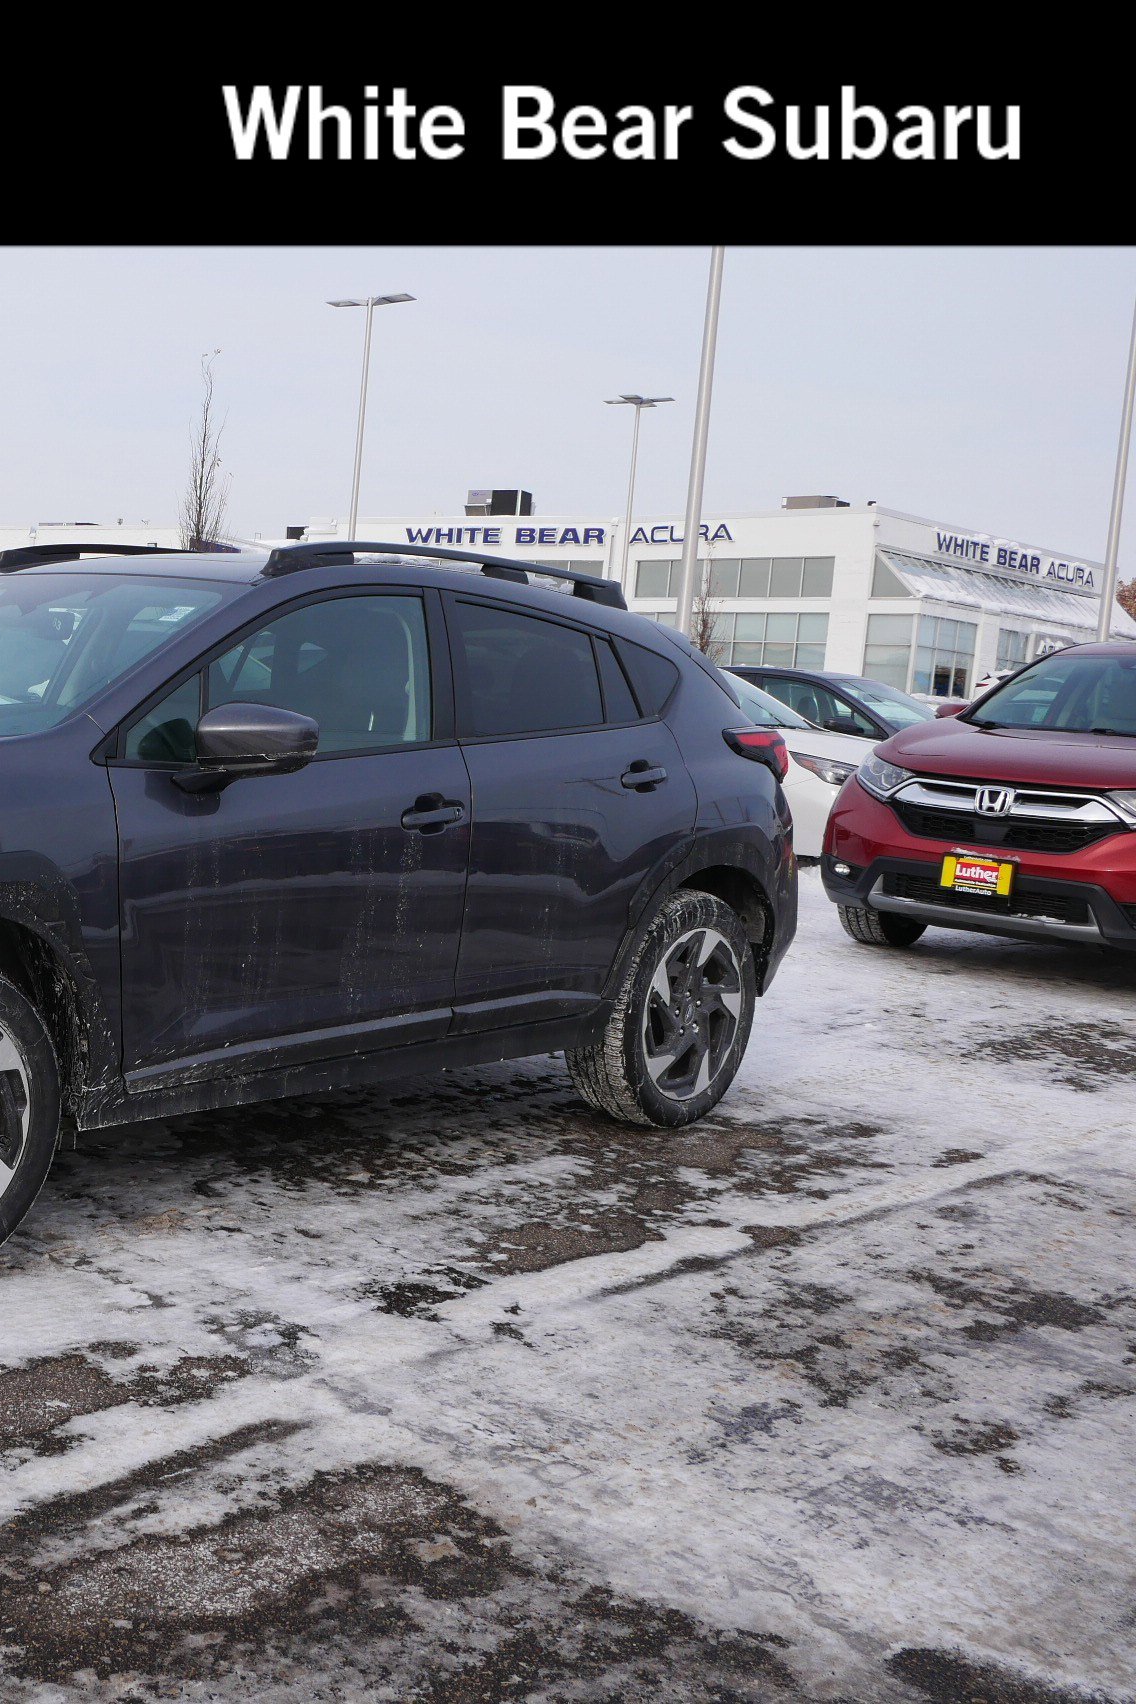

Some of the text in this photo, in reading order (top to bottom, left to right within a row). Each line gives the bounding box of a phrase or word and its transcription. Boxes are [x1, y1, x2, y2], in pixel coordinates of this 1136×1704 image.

[405, 527, 501, 544] WHITE
[514, 527, 605, 545] BEAR
[937, 532, 1094, 587] WHITE BEAR ACURA
[955, 864, 998, 883] Luther
[955, 885, 992, 895] LutherAuto
